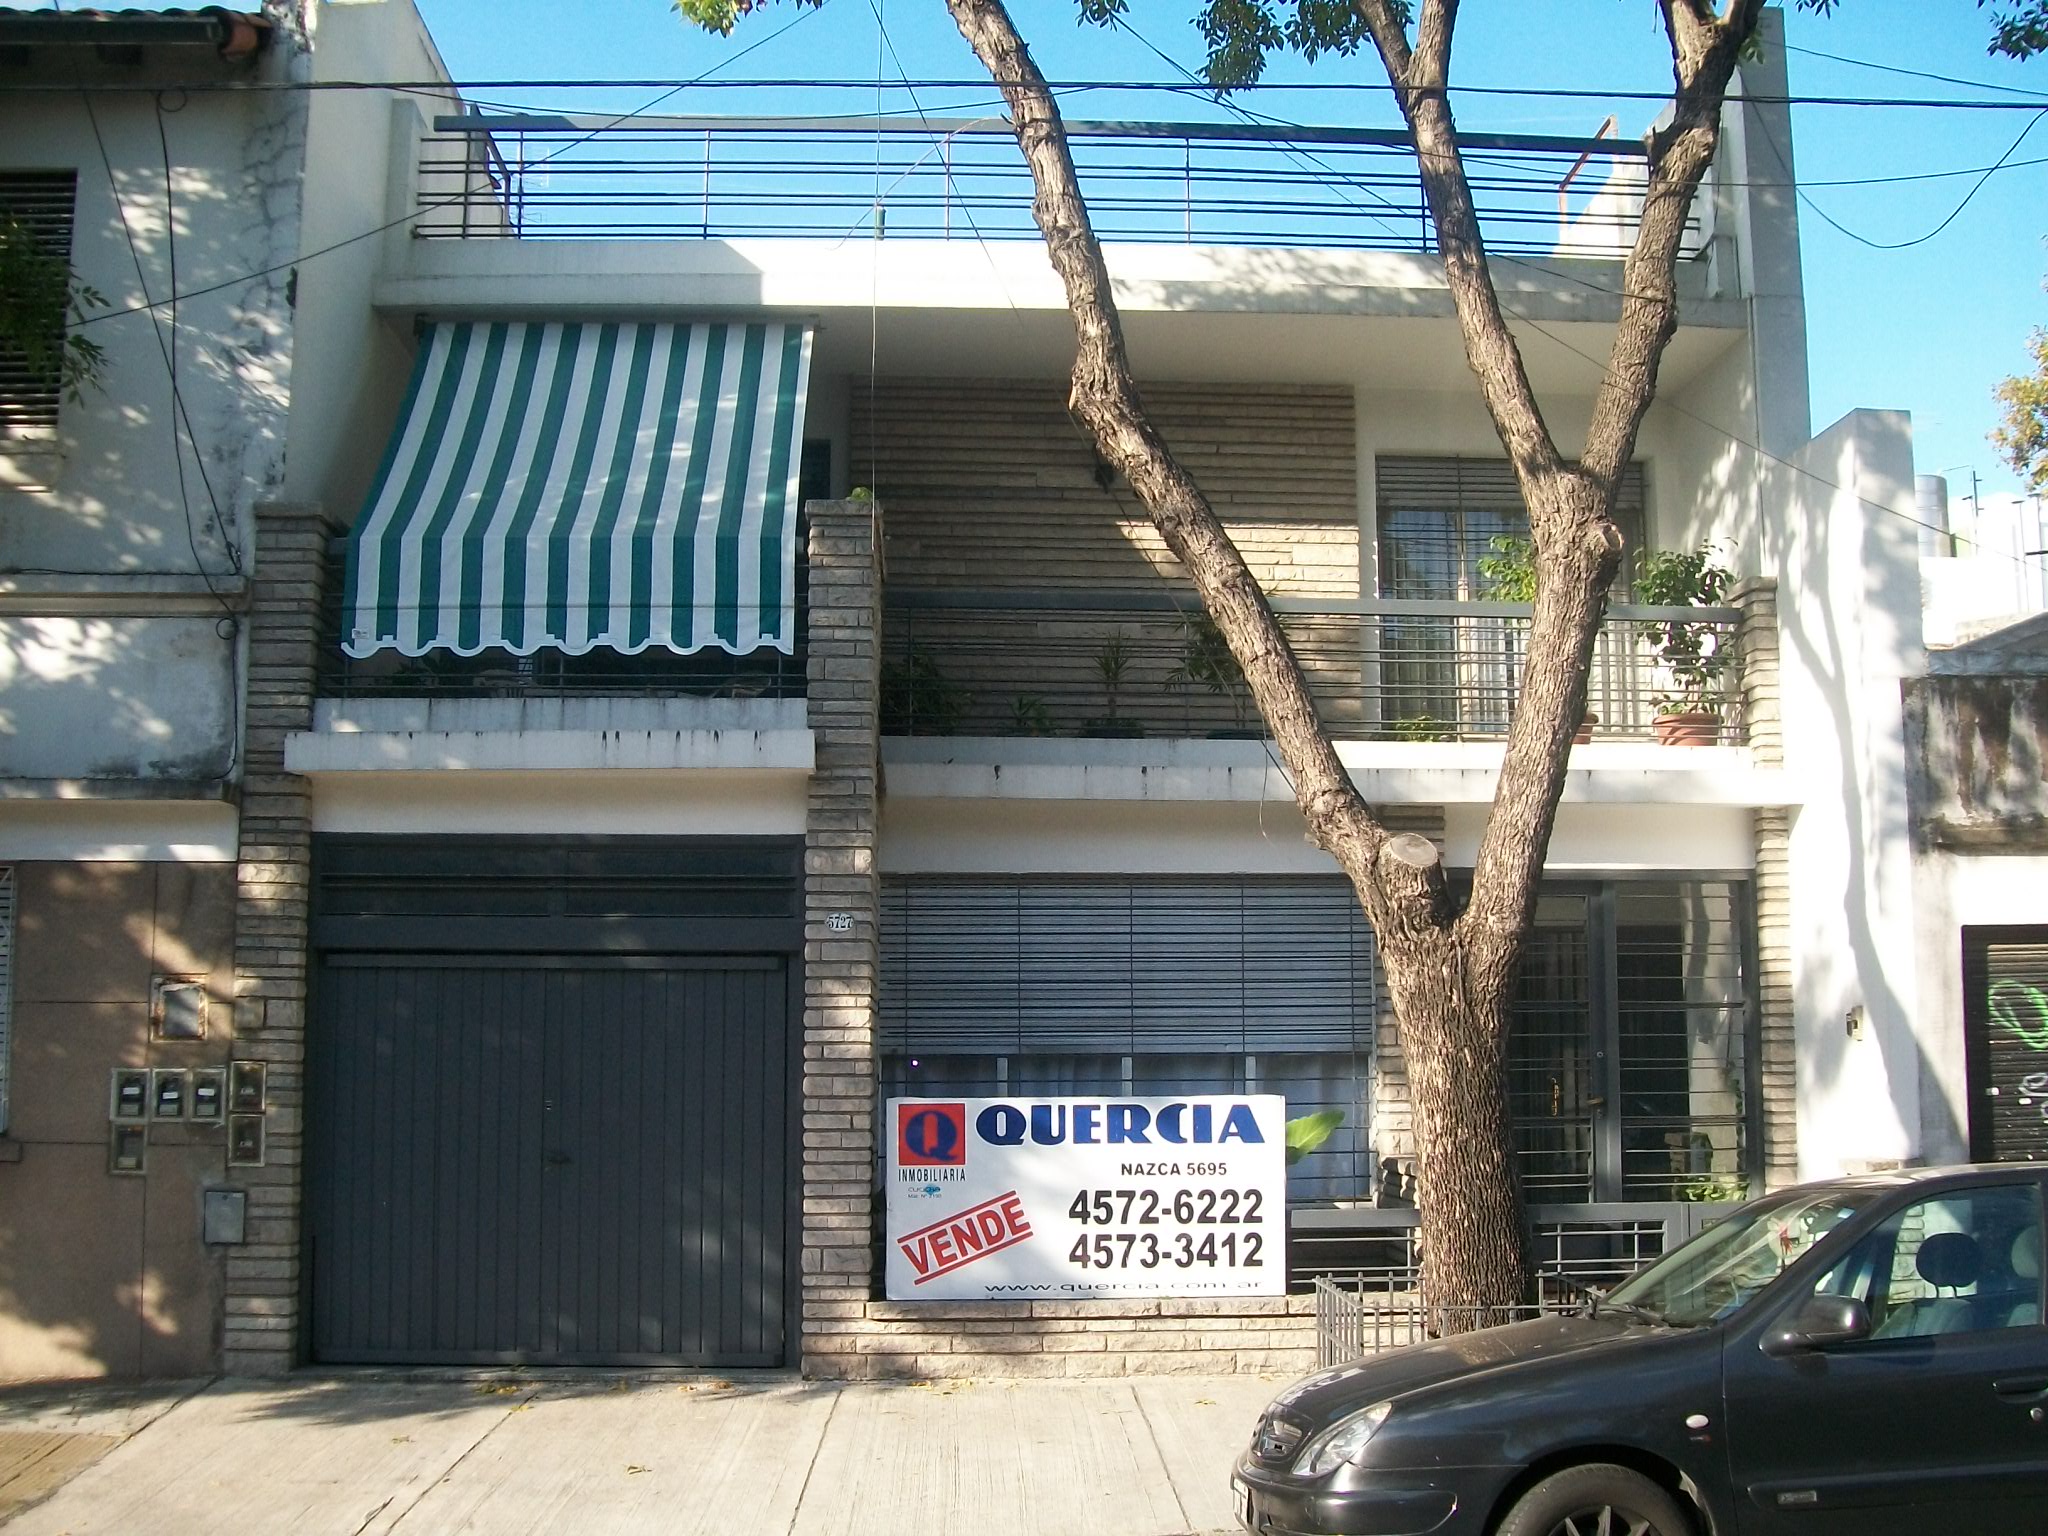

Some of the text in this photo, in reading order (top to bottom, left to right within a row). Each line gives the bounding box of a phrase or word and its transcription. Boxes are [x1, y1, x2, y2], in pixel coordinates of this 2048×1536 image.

[828, 916, 852, 928] 5727
[904, 1110, 957, 1162] Q
[975, 1103, 1266, 1146] QUERCIA
[898, 1168, 966, 1182] INMOBILIARIA
[1120, 1162, 1228, 1176] NAZCA 5695
[1069, 1189, 1263, 1225] 4572-6222
[902, 1203, 1031, 1276] VENDE
[1069, 1232, 1263, 1269] 4573-3412
